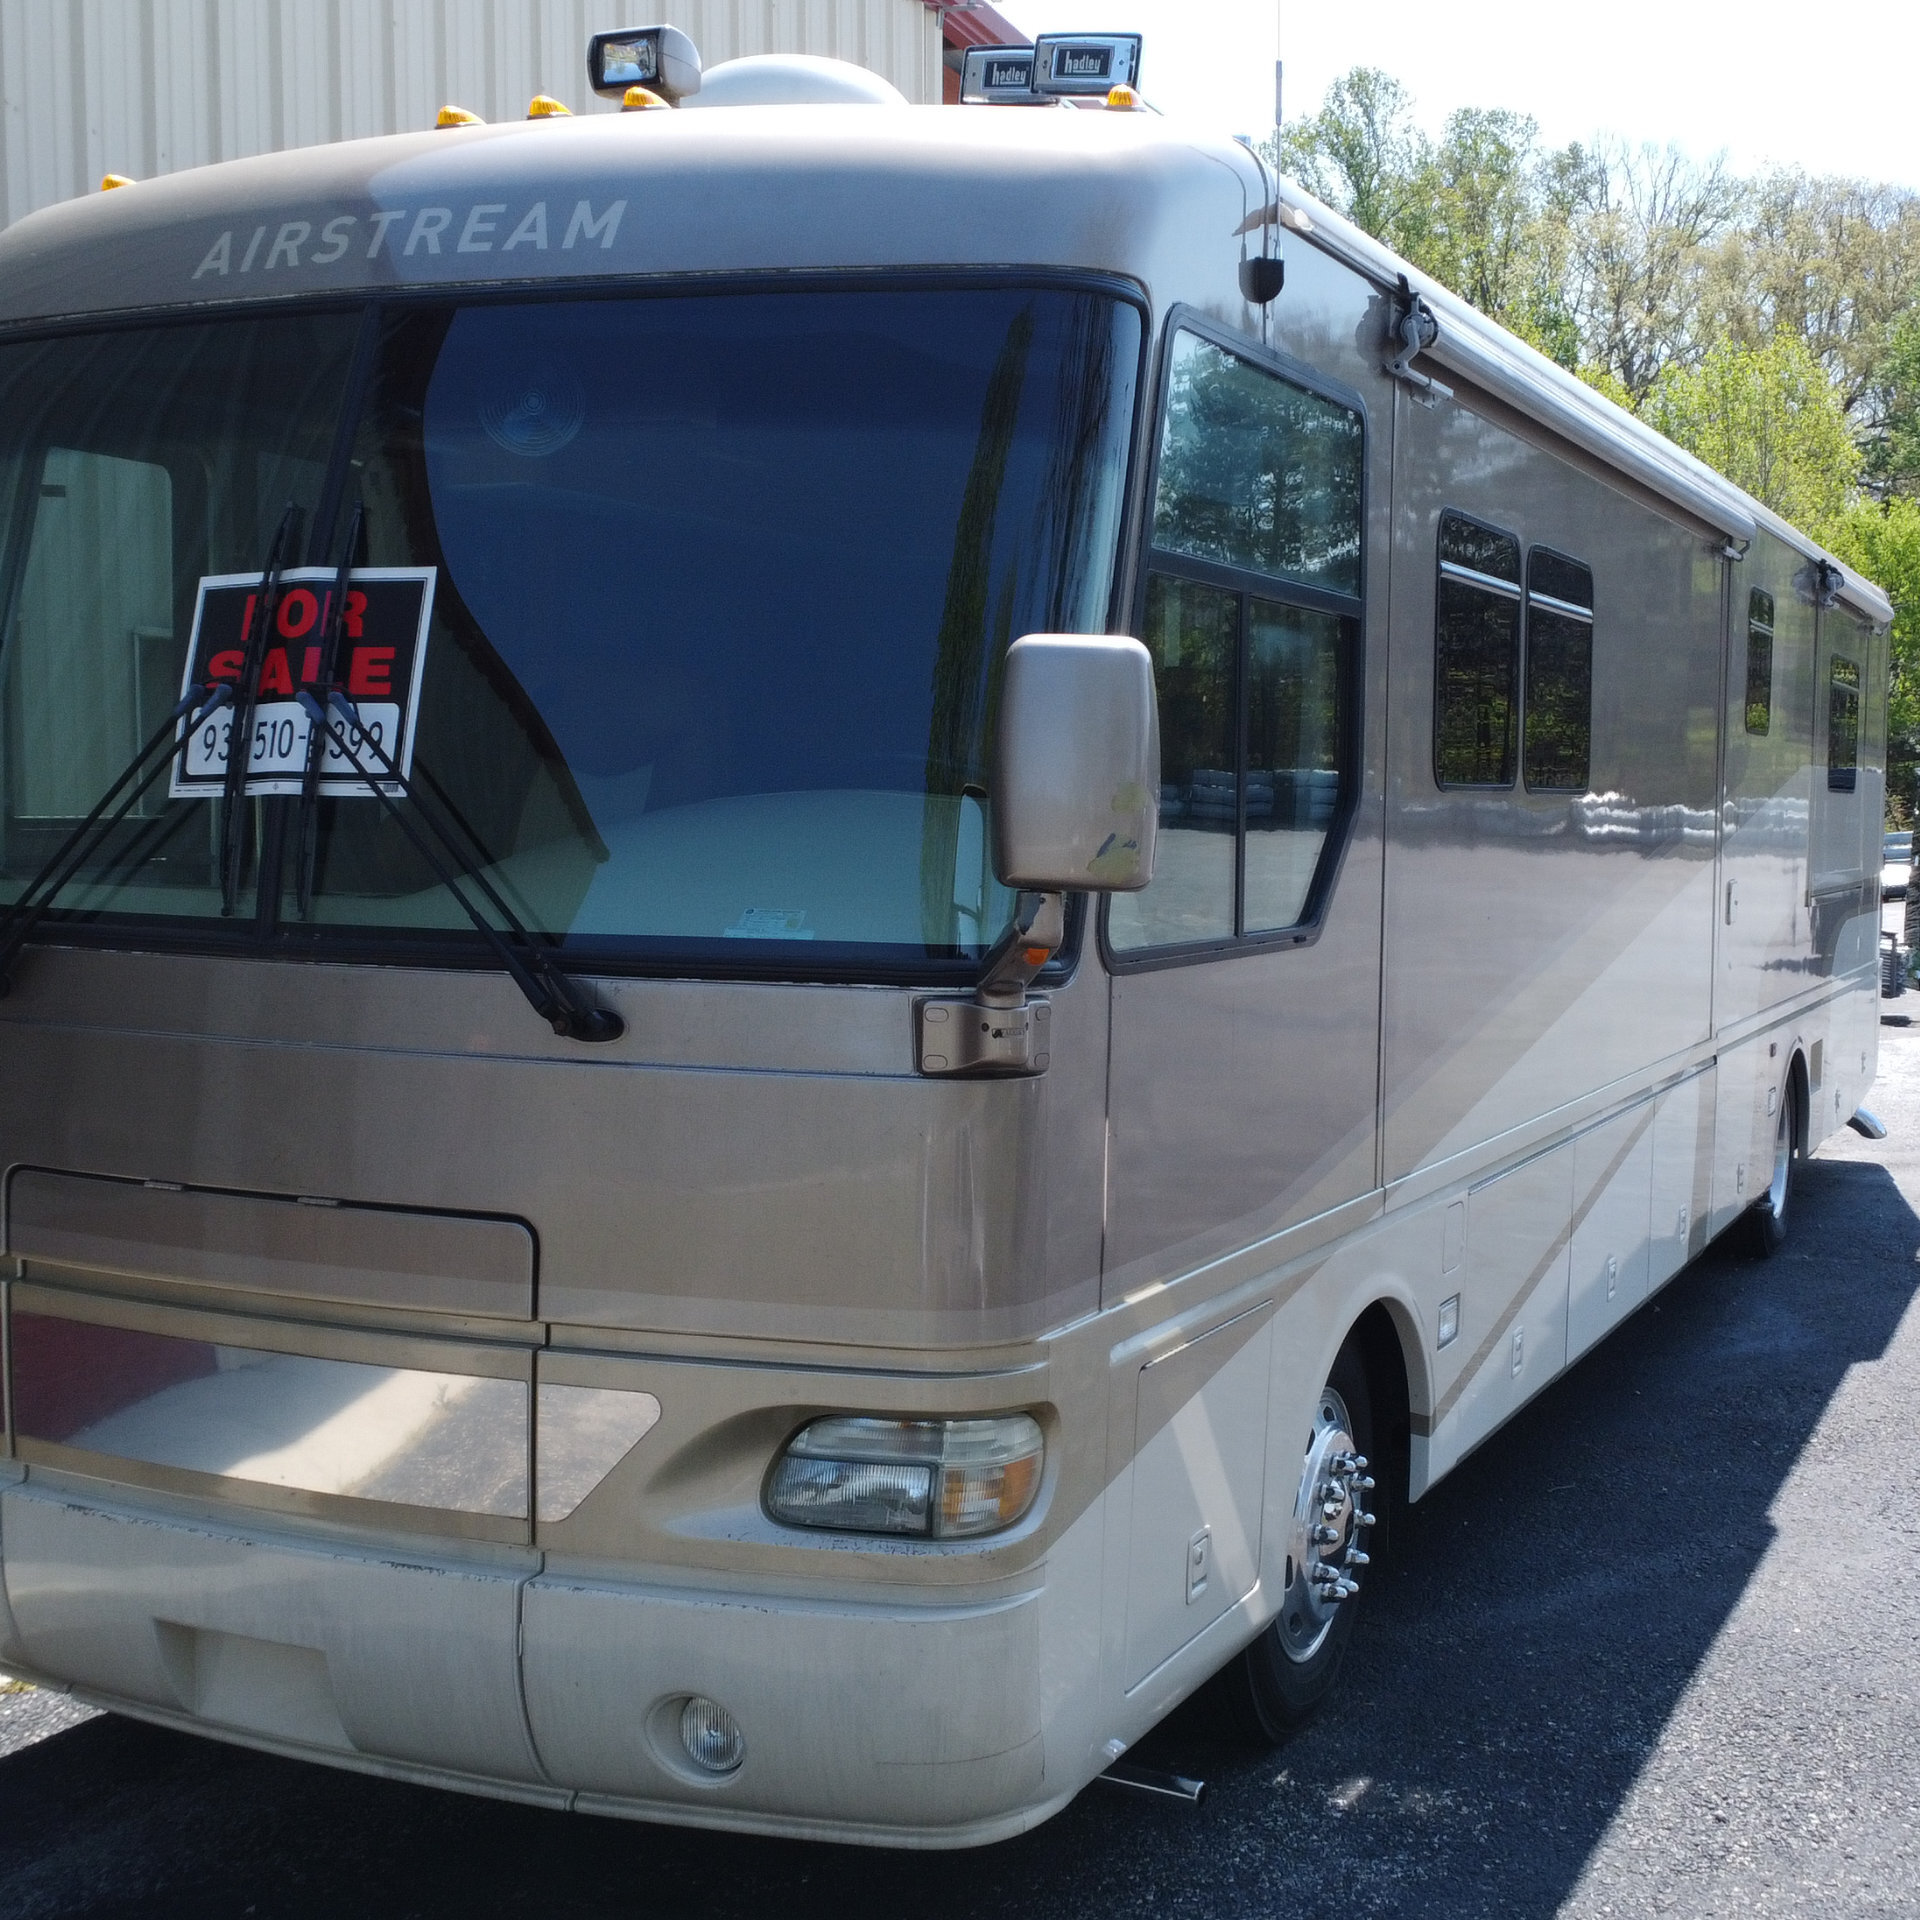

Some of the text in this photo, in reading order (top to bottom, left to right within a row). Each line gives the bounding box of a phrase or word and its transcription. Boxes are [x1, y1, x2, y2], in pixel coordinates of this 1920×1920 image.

[991, 63, 1027, 86] hadley
[1064, 51, 1101, 74] hadley
[191, 200, 628, 279] AIRSTREAM
[205, 646, 395, 696] SALE
